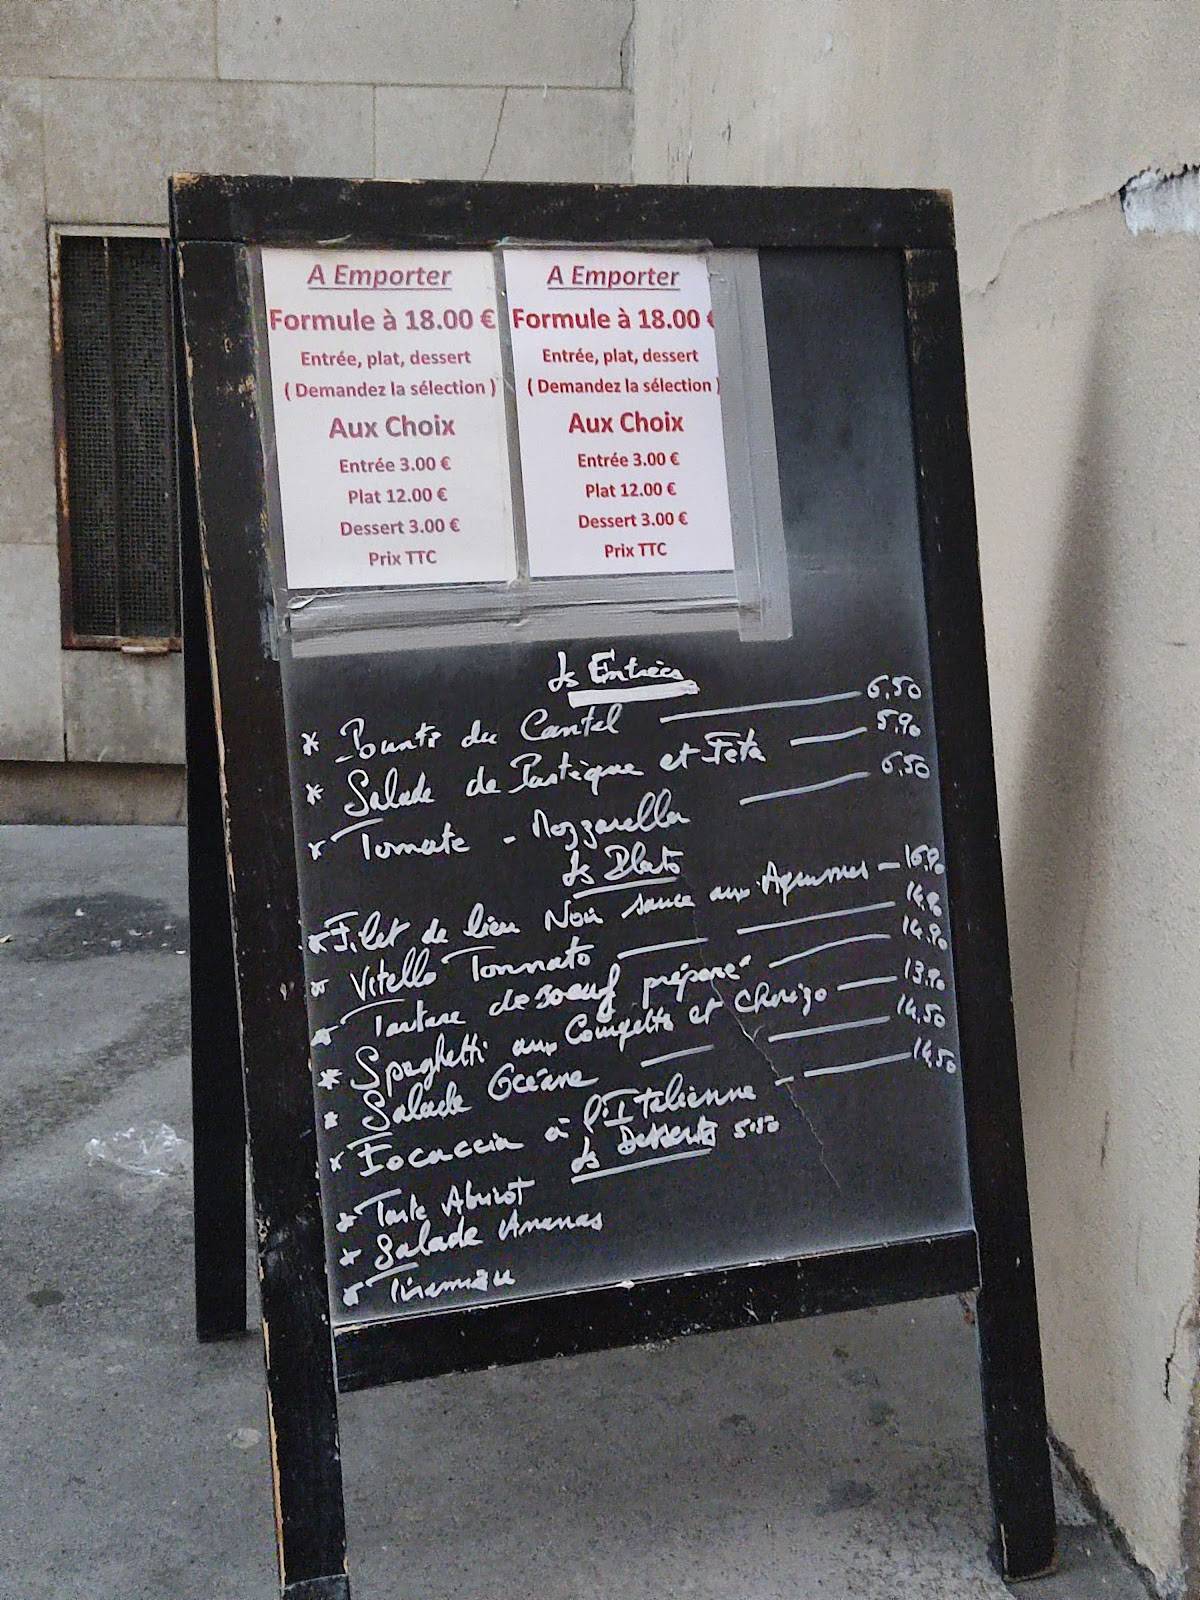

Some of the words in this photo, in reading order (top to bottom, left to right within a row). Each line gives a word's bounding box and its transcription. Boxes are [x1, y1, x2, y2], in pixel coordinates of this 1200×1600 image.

[307, 264, 325, 285] A
[334, 264, 452, 288] Emporter
[547, 265, 563, 285] A
[571, 265, 680, 289] Emporter
[269, 308, 375, 331] Formule
[384, 309, 397, 331] à
[405, 309, 474, 331] 18.00
[480, 309, 496, 329] €
[512, 308, 611, 330] Formule
[618, 307, 631, 329] à
[638, 308, 701, 330] 18.00
[301, 351, 362, 369] Entrée,
[367, 351, 405, 370] plat,
[410, 350, 471, 365] dessert
[542, 348, 599, 366] Entrée,
[603, 349, 638, 367] plat,
[643, 348, 699, 363] dessert
[391, 381, 406, 397] la
[625, 377, 639, 393] la
[329, 417, 379, 439] Aux
[385, 414, 456, 437] Choix
[568, 412, 613, 434] Aux
[620, 411, 684, 433] Choix
[339, 457, 395, 474] Entrée
[400, 456, 436, 472] 3.00
[440, 456, 452, 471] €
[577, 452, 629, 468] Entrée
[633, 452, 666, 467] 3.00
[670, 451, 680, 466] €
[348, 489, 382, 505] Plat
[386, 488, 432, 504] 12.00
[437, 487, 448, 502] €
[586, 483, 616, 499] Plat
[620, 482, 662, 498] 12.00
[667, 482, 677, 496] €
[340, 520, 405, 537] Dessert
[408, 518, 445, 534] 3.00
[450, 518, 461, 533] €
[578, 513, 636, 529] Dessert
[642, 512, 674, 527] 3.00
[678, 511, 689, 526] €
[369, 551, 401, 567] Prix
[405, 550, 438, 565] TTC
[604, 544, 635, 559] Prix
[637, 542, 667, 557] TTC
[461, 719, 498, 748] du
[465, 765, 501, 797] de
[659, 742, 701, 772] et
[421, 918, 448, 945] de
[488, 989, 530, 1017] de
[688, 997, 724, 1025] et
[374, 1216, 484, 1271] Salade
